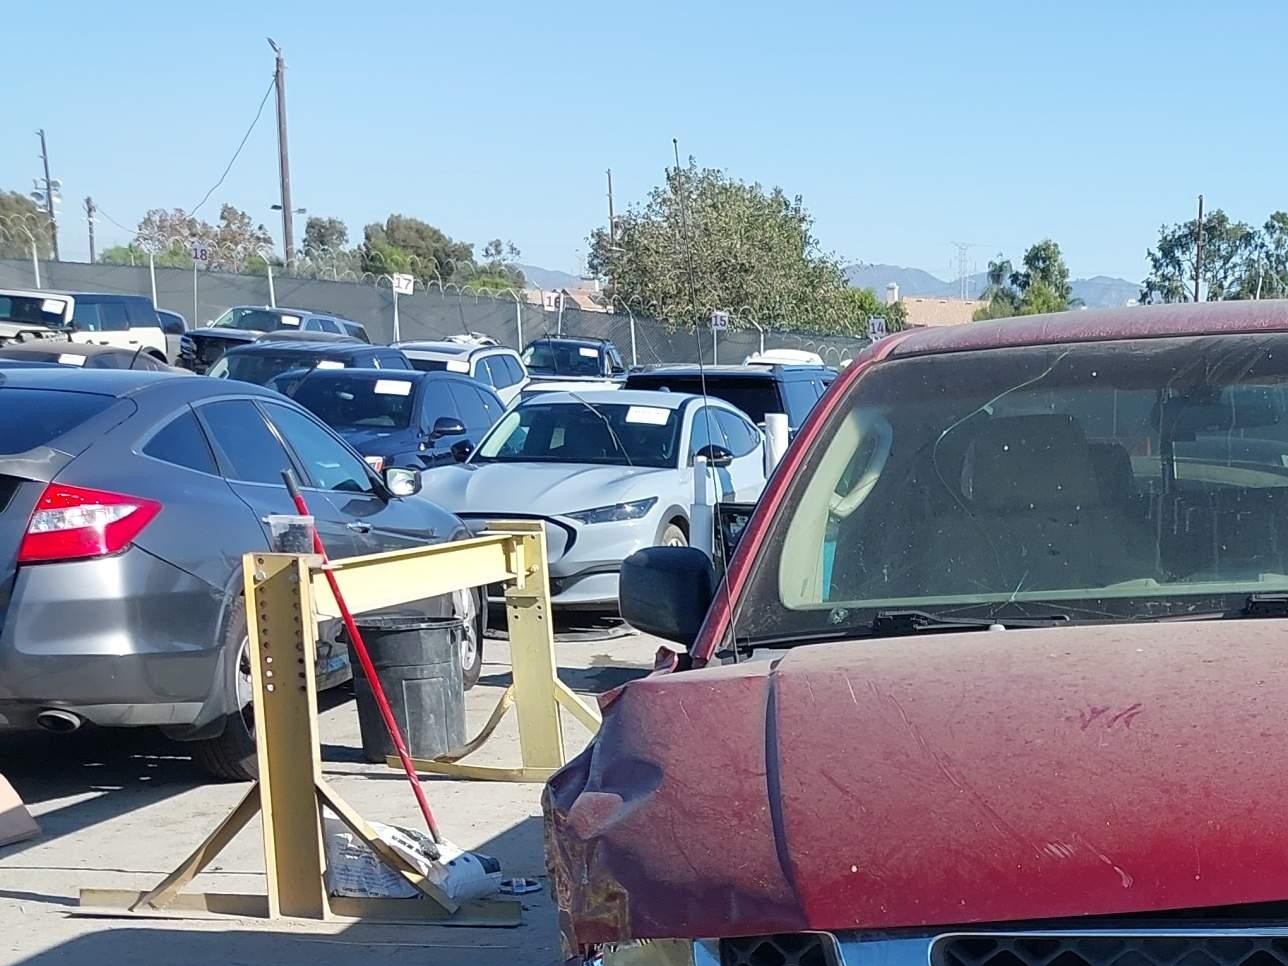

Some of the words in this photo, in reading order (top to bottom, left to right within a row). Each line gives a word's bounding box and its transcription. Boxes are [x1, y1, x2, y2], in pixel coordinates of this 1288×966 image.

[193, 248, 207, 260] 18
[395, 277, 412, 290] 17
[713, 315, 727, 327] 15
[871, 322, 884, 334] 14
